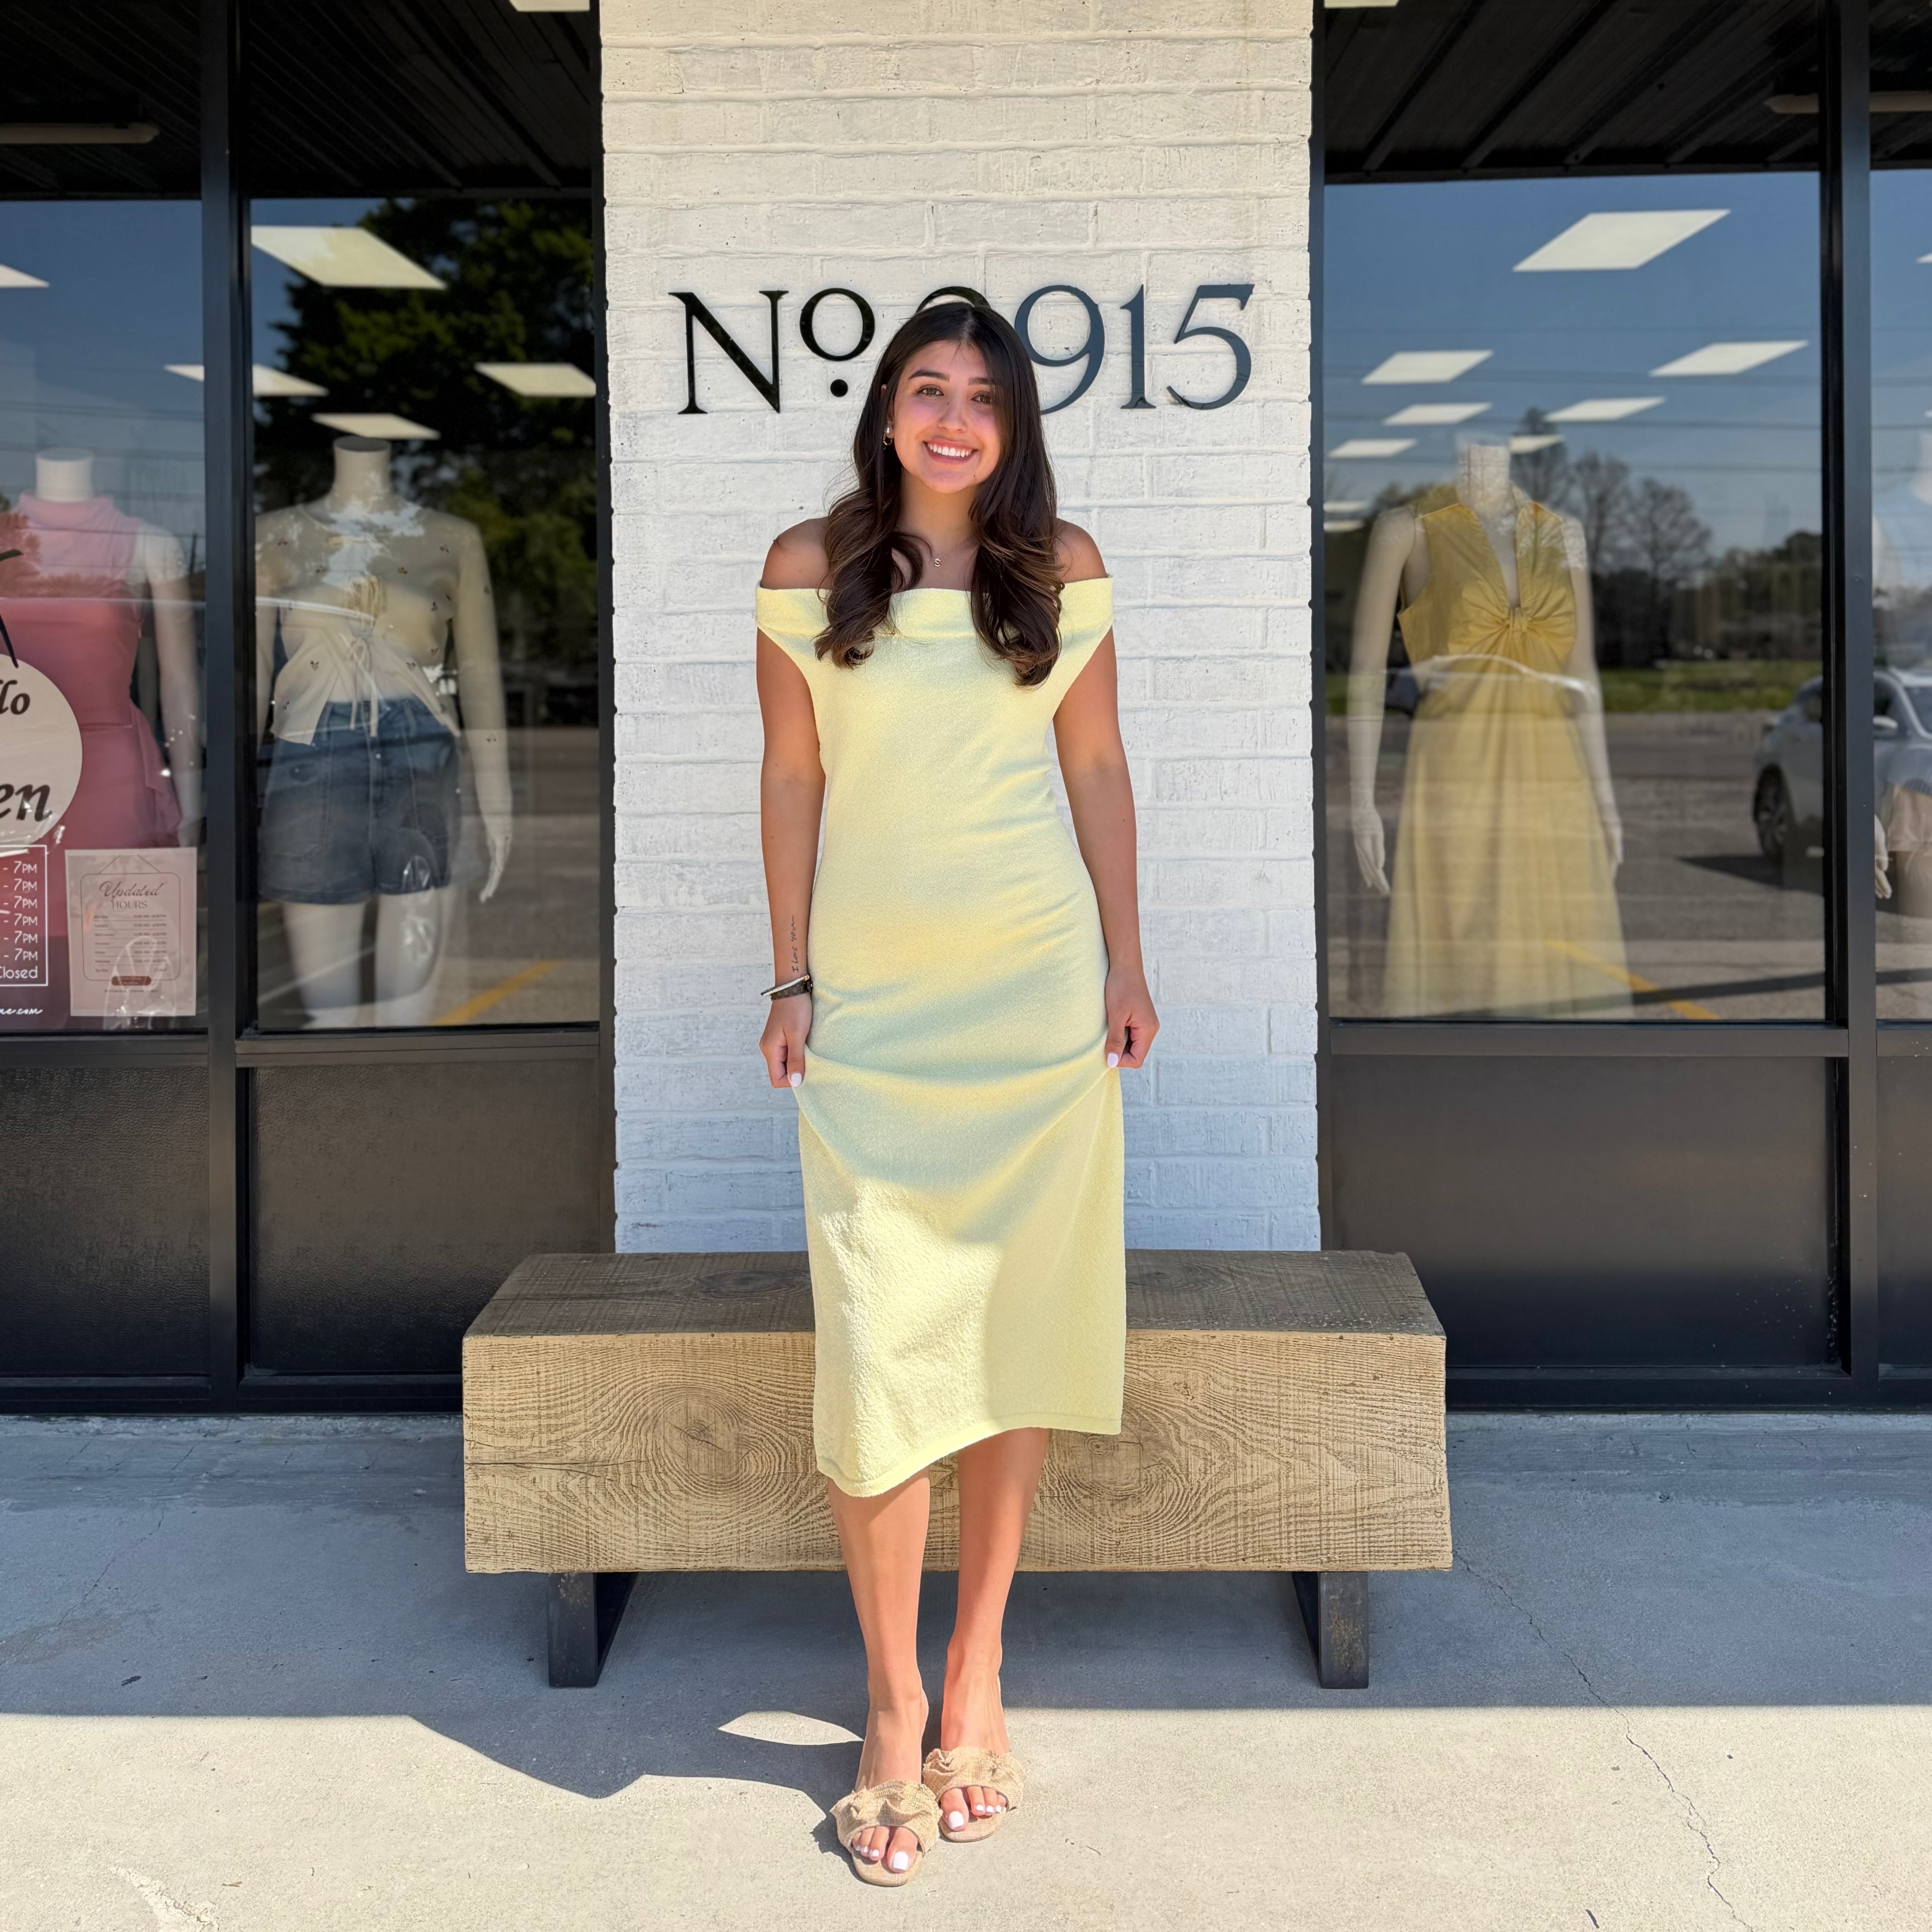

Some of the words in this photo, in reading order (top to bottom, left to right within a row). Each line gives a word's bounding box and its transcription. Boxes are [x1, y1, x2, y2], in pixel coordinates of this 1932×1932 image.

[916, 283, 1256, 415] 915
[0, 679, 31, 715] lo
[14, 861, 37, 874] 7PM
[14, 878, 37, 891] 7PM
[99, 881, 164, 902] Updated
[14, 896, 38, 909] 7PM
[112, 901, 148, 909] HOURS
[14, 913, 38, 926] 7PM
[15, 931, 38, 943] 7PM
[15, 948, 38, 961] 7PM
